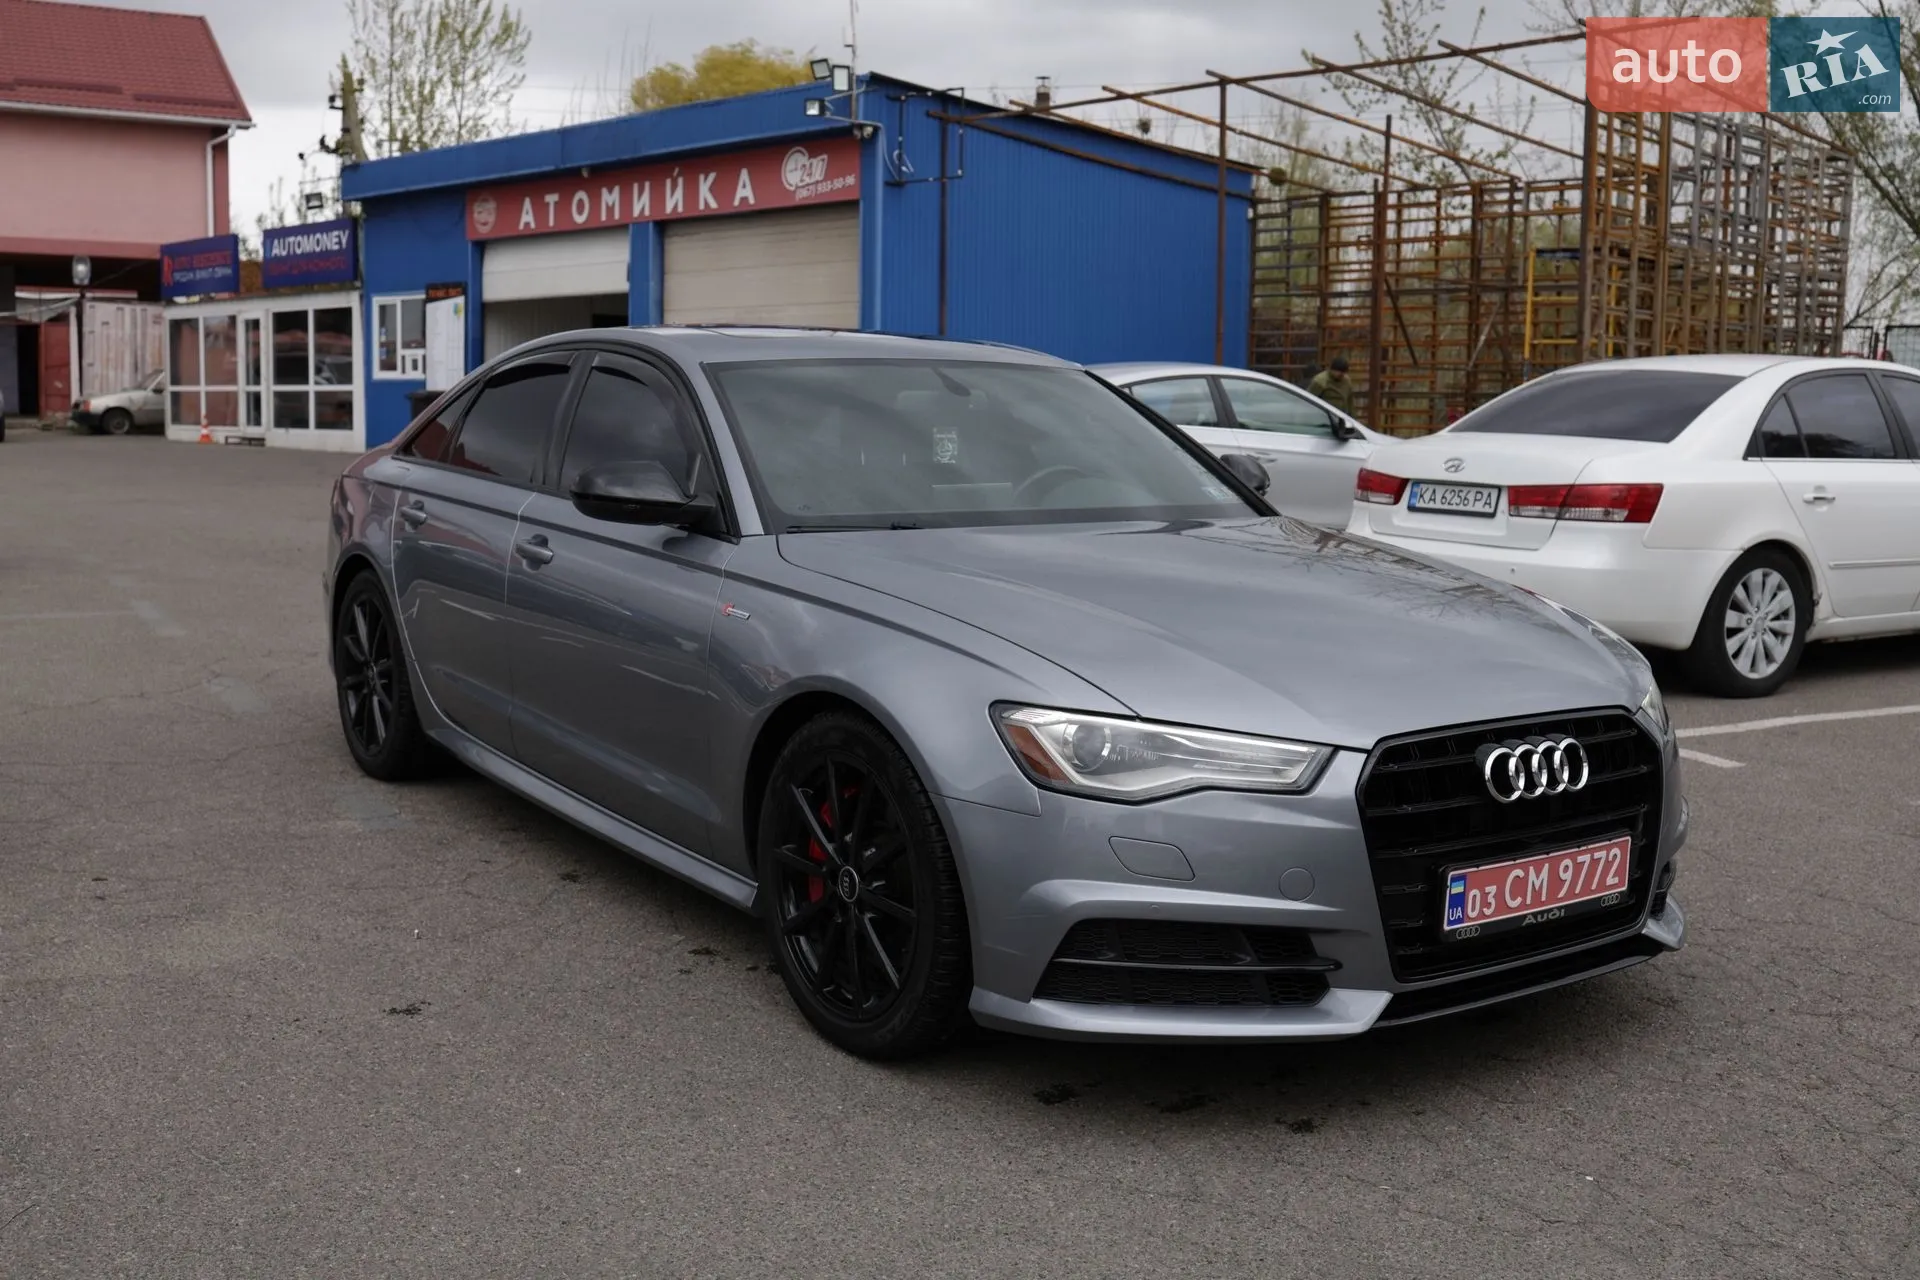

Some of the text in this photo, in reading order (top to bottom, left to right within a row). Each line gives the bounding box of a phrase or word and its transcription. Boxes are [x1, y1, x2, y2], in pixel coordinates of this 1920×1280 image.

[518, 167, 756, 231] АТОМИЙКА
[271, 229, 349, 257] AUTOMONEY
[1417, 488, 1492, 509] KA 6256 PA
[1467, 847, 1621, 919] 03 CM 9772
[1449, 906, 1463, 921] UA
[1522, 909, 1565, 926] Audi
